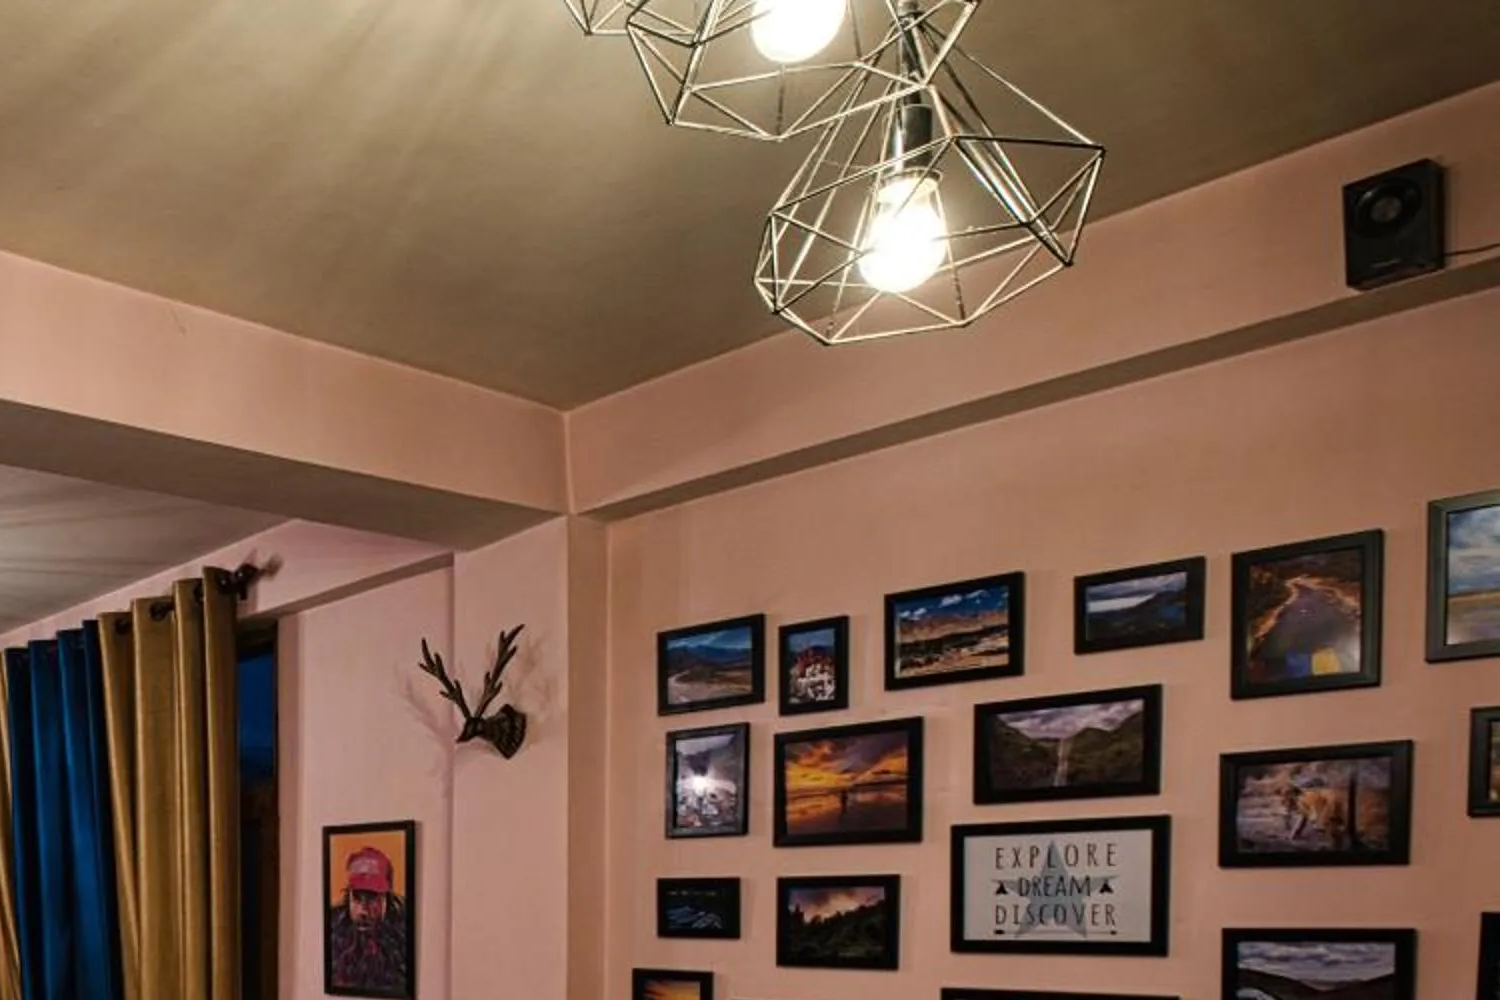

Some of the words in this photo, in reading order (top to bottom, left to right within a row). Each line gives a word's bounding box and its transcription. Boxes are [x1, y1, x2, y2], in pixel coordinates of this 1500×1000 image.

[994, 843, 1117, 870] EXPLORE
[1018, 874, 1092, 897] DREAM
[994, 903, 1116, 926] DISCOVER
